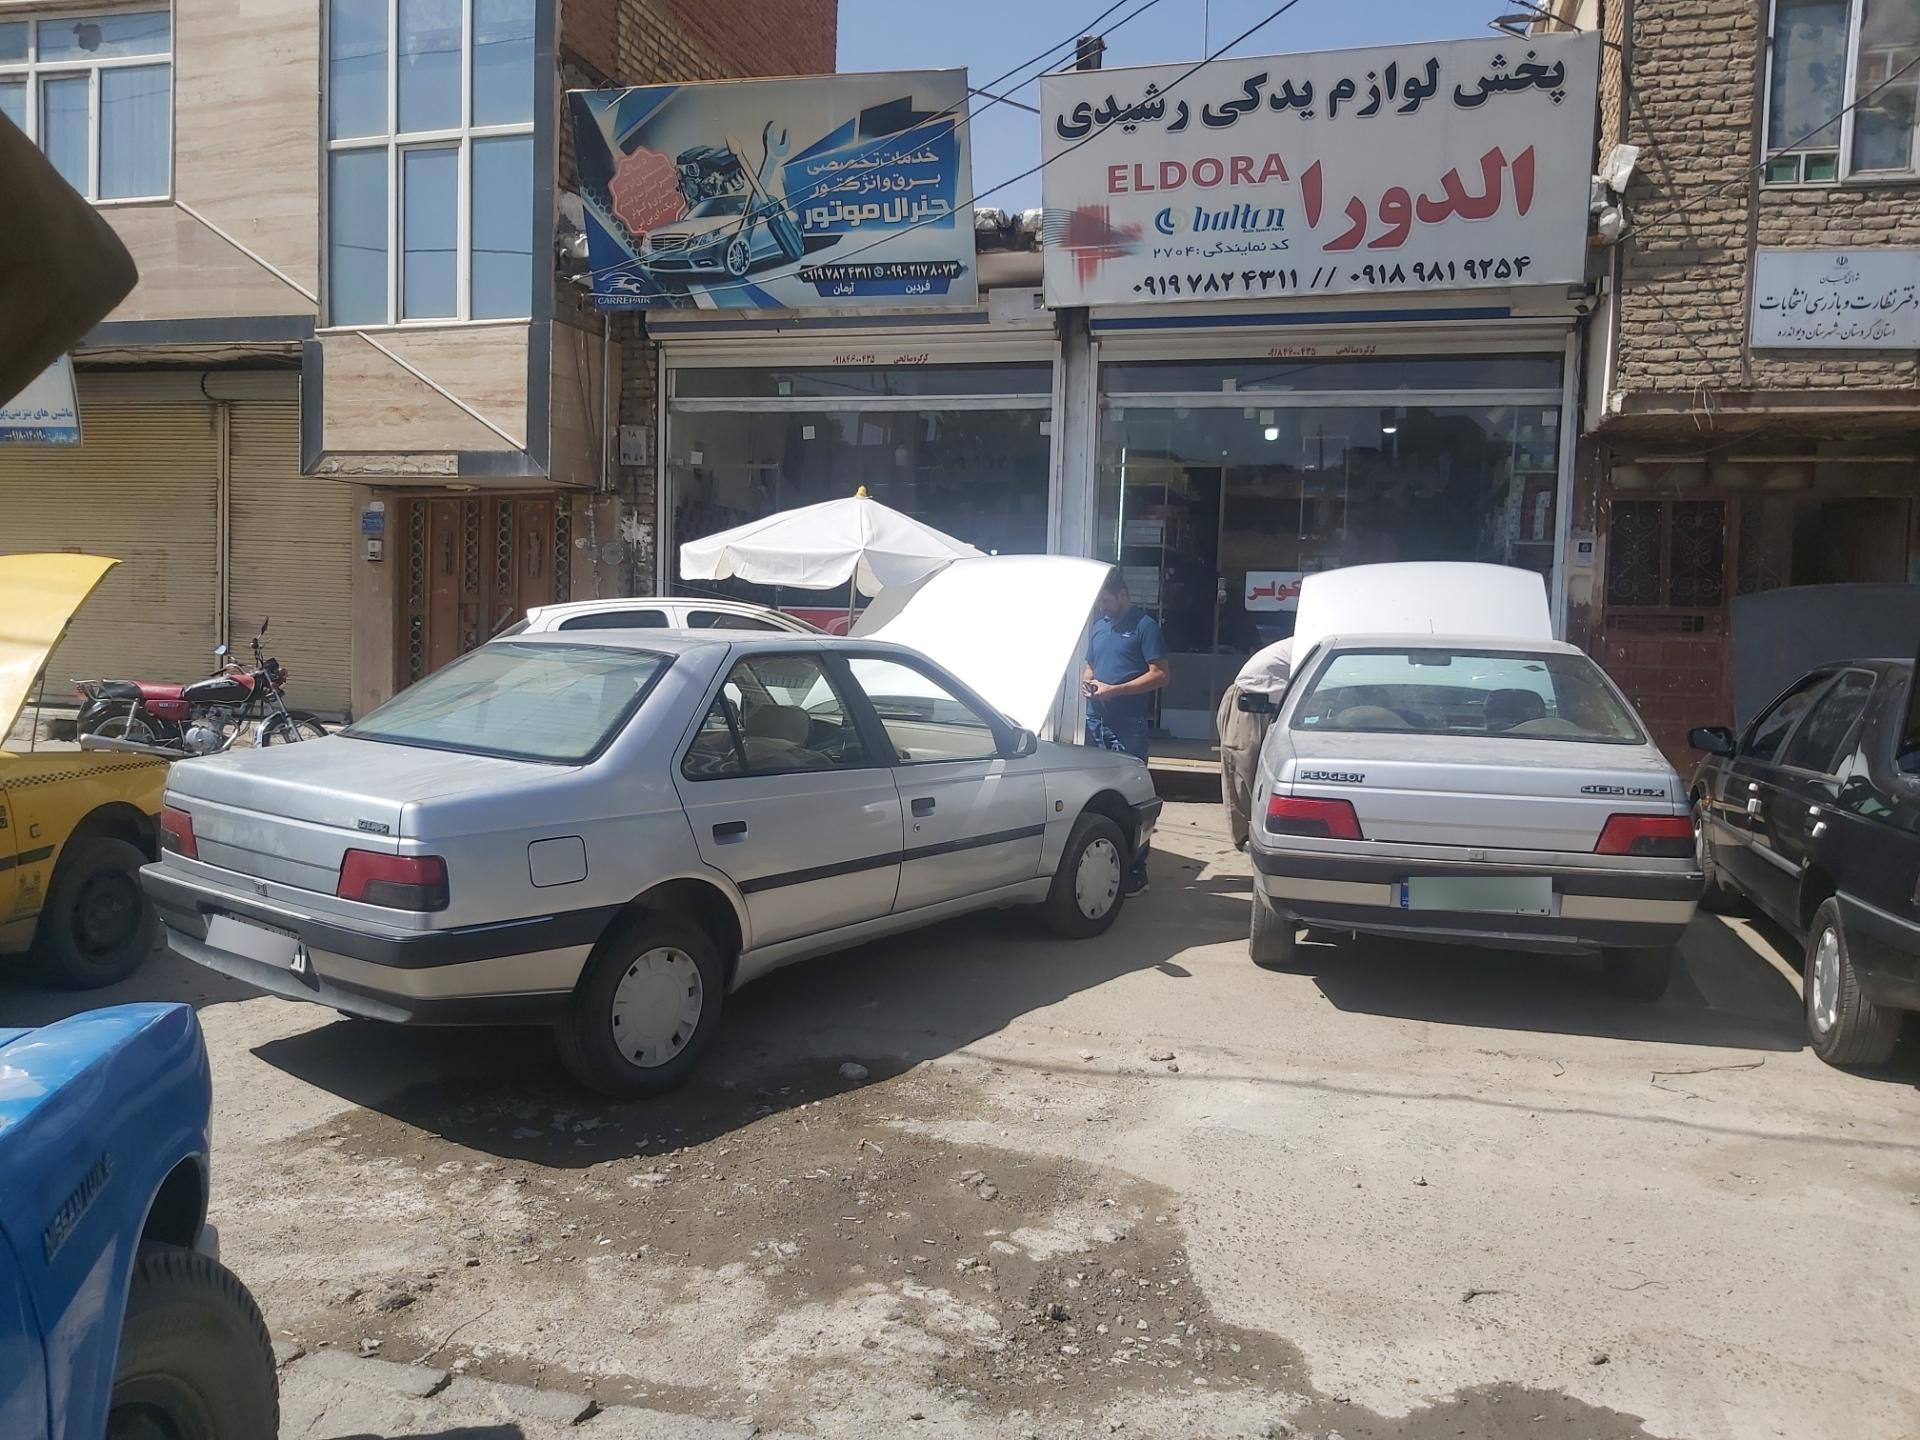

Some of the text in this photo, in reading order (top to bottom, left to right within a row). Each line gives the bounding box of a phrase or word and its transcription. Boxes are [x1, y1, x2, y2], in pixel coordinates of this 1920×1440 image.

[1055, 50, 1567, 139] پخش لوازم یدکی رشیدی
[806, 146, 940, 176] خدمات تخصصی
[1107, 152, 1290, 194] ELDORA
[1300, 143, 1536, 254] الدورا
[803, 199, 881, 230] موتور
[1270, 238, 1290, 251] کد
[833, 279, 931, 296] فردین آرمان
[1759, 287, 1808, 317] انتخابات
[1850, 288, 1896, 310] نظارت
[1891, 285, 1919, 314] دفتر
[1805, 291, 1842, 316] بازرسی
[1300, 770, 1365, 783] PEUGEOT
[1580, 785, 1665, 798] 405 GLX
